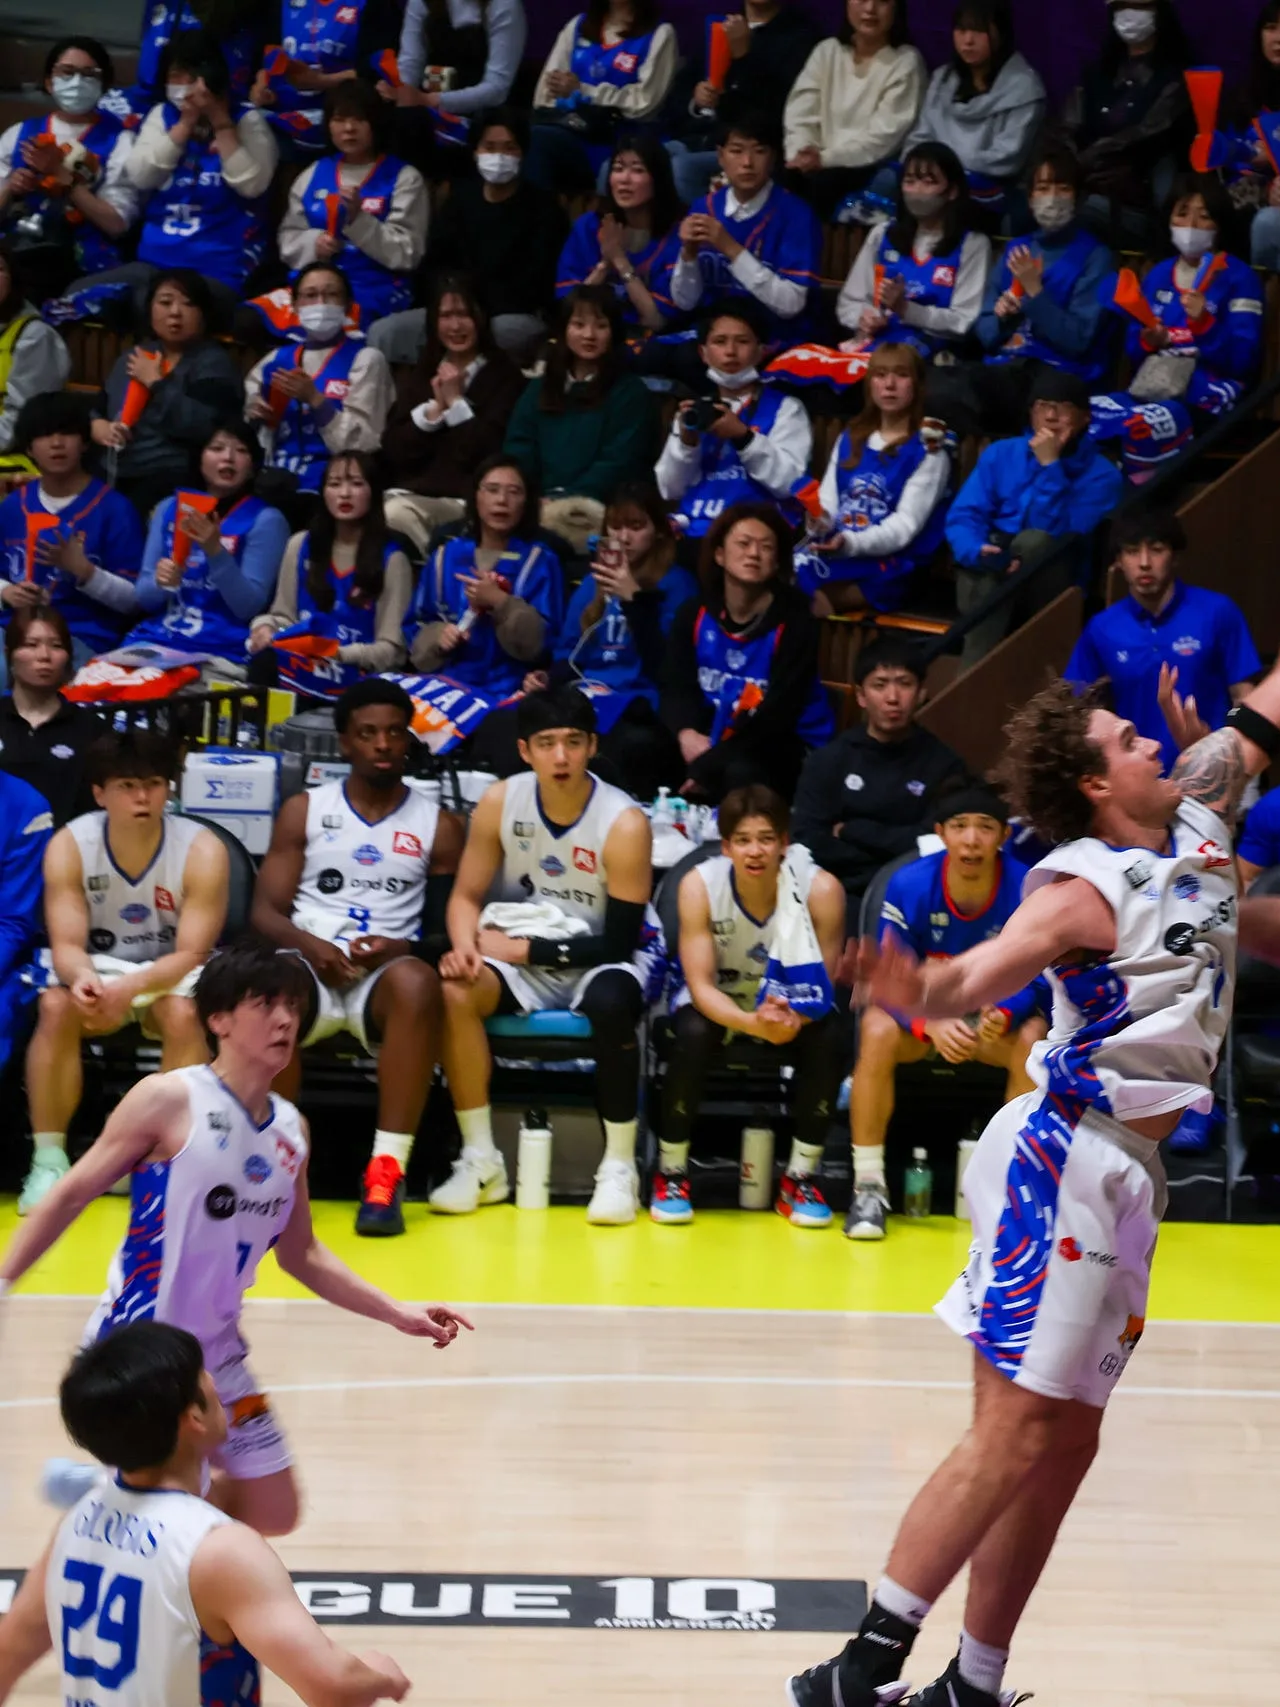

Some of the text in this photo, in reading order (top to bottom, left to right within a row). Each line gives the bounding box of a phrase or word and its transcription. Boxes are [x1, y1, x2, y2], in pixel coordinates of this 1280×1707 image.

[572, 888, 597, 907] ST
[294, 1577, 776, 1622] GUE 10
[62, 1558, 143, 1691] 29
